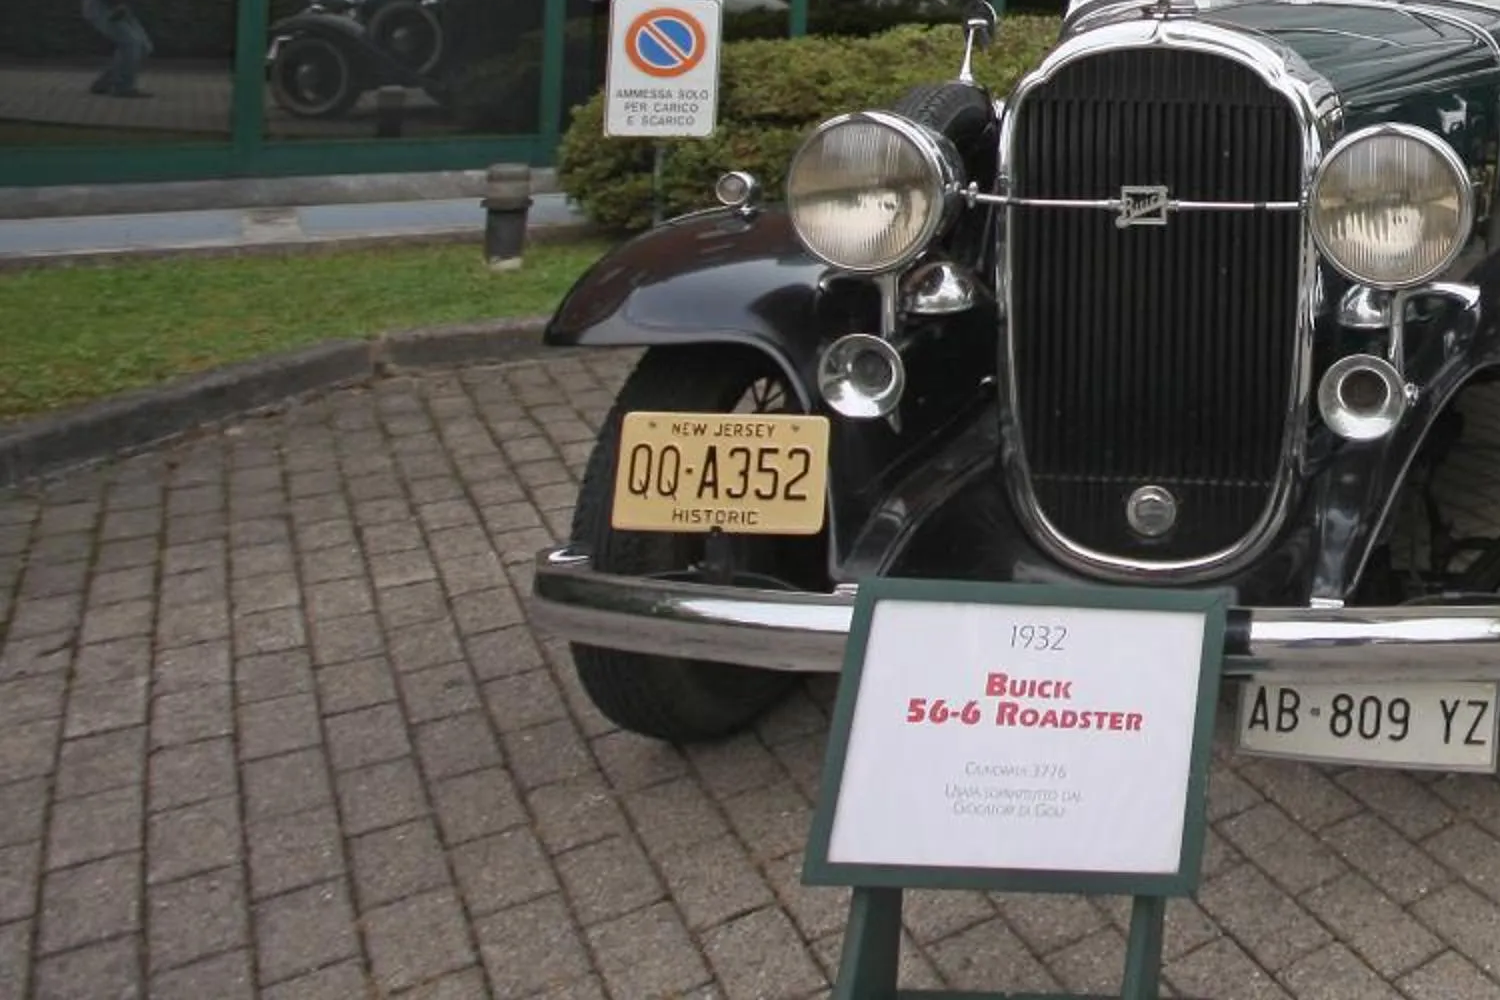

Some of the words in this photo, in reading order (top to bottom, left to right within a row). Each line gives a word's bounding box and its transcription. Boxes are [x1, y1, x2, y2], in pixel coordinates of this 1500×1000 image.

[616, 88, 673, 99] AMMESSA
[678, 89, 709, 100] SOLO
[624, 102, 648, 113] PER
[653, 102, 699, 113] CARICO
[626, 116, 634, 126] E
[641, 116, 696, 126] SCARICO
[671, 422, 707, 436] NEW
[713, 423, 776, 438] JERSEY
[671, 508, 761, 525] HISTORIC
[1010, 624, 1068, 651] 1932
[985, 672, 1073, 700] BUICK
[906, 697, 981, 726] 56-6
[995, 701, 1143, 731] ROADSTER
[1329, 692, 1411, 741] 809
[1439, 698, 1489, 746] YZ
